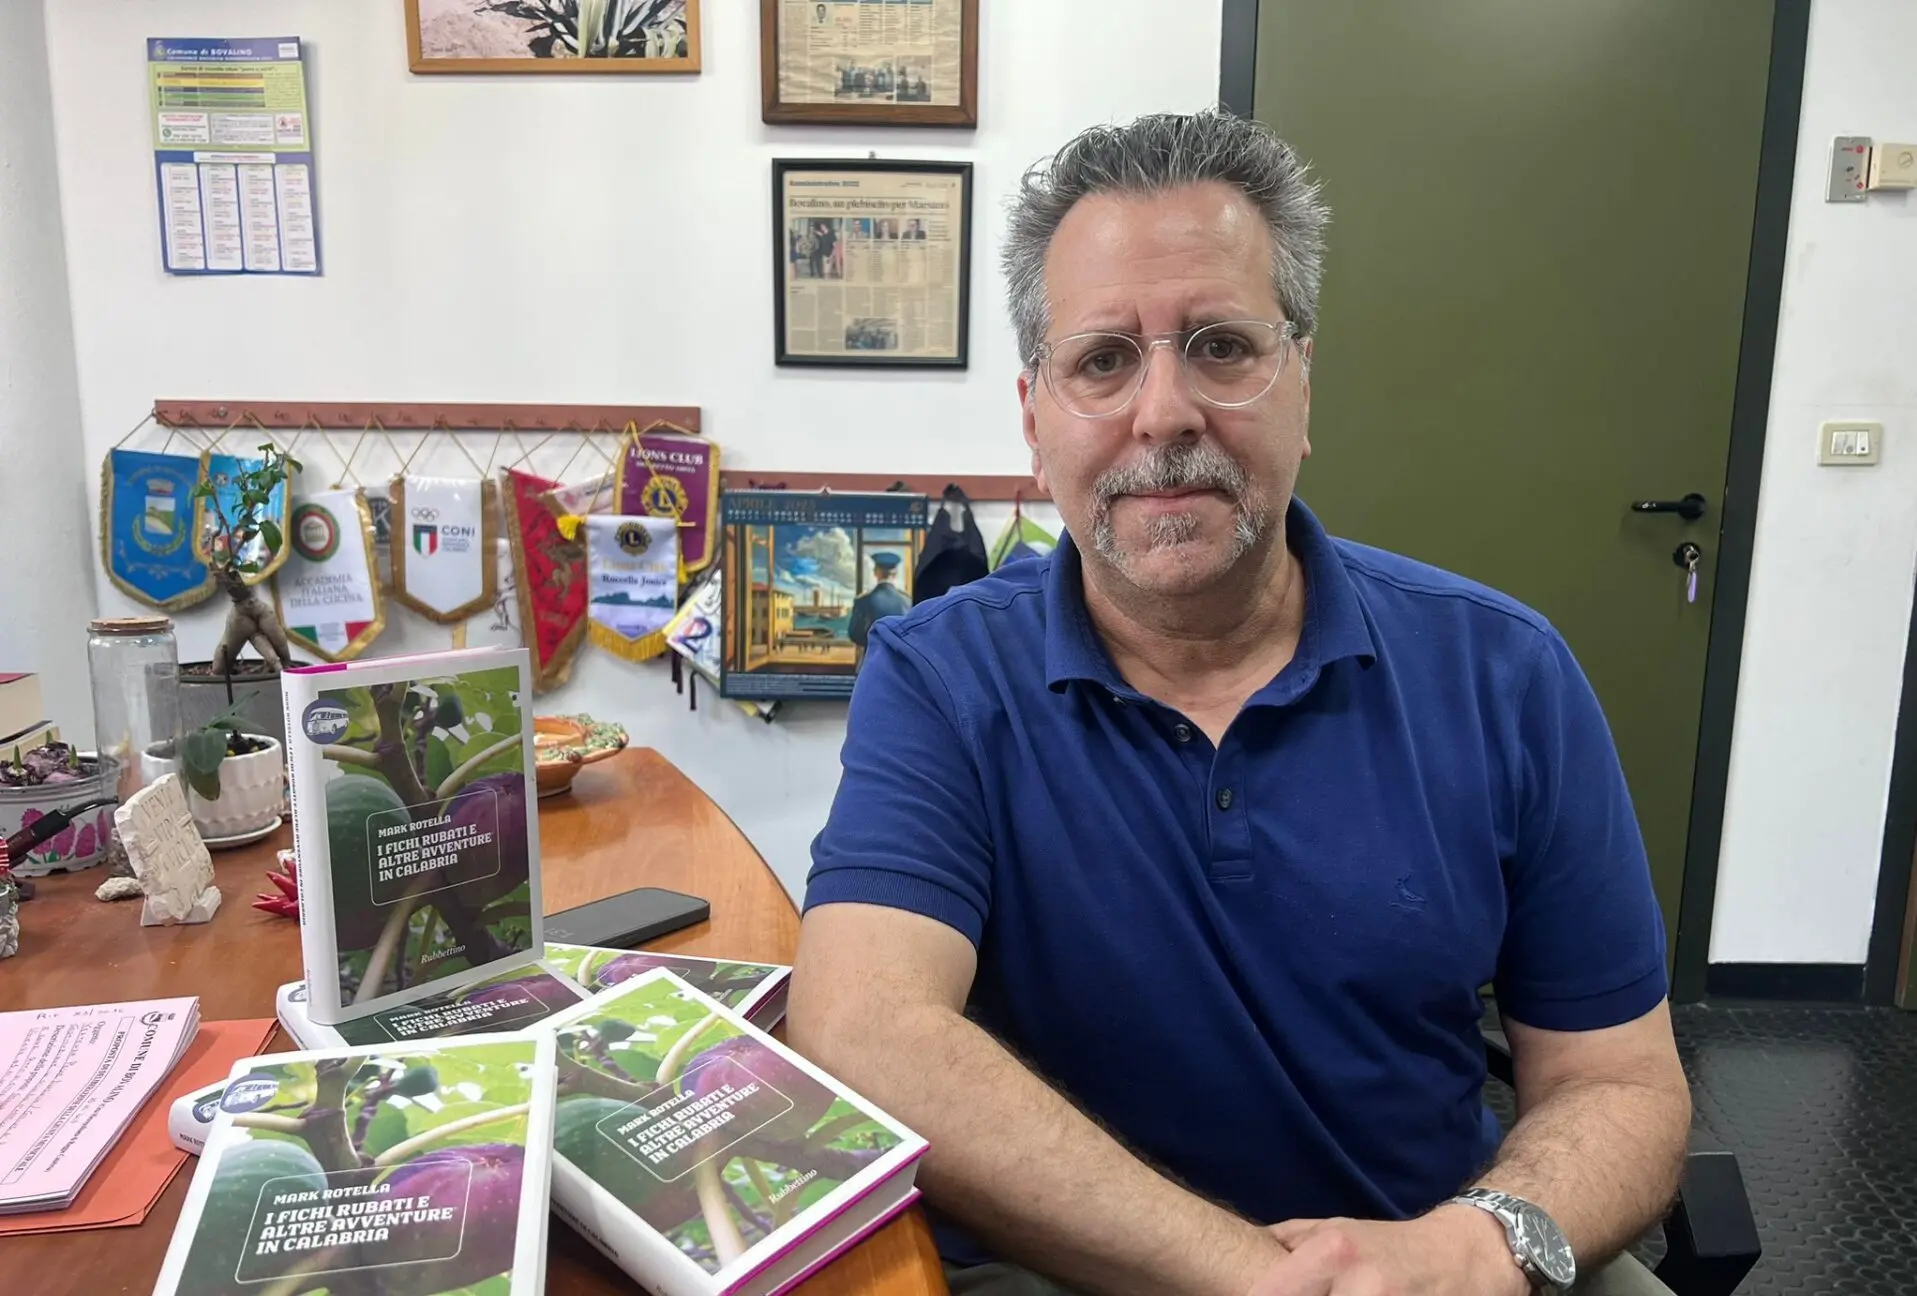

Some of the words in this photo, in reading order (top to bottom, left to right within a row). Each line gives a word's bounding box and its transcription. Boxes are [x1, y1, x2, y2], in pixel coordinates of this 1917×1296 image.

[211, 48, 252, 56] BOVALINO
[630, 447, 667, 461] LIONS
[669, 452, 704, 465] CLUB
[441, 524, 476, 538] CONI
[295, 572, 353, 587] ACCADEMIA
[601, 573, 639, 584] Roccella
[377, 845, 383, 857] I
[385, 837, 420, 855] FICHI
[422, 828, 468, 847] RUBATI
[469, 824, 477, 835] E
[378, 824, 408, 838] MARK
[409, 815, 451, 831] ROTELLA
[378, 850, 420, 869] ALTRE
[421, 832, 492, 859] AVVENTURE
[379, 869, 394, 882] IN
[396, 853, 458, 878] CALABRIA
[421, 944, 466, 964] Rubbettino
[389, 1010, 420, 1022] MARK
[424, 1000, 472, 1014] ROTELLA
[397, 1017, 443, 1032] ALTRE
[444, 998, 530, 1022] AVVENTURE
[419, 1011, 493, 1033] CALABRIA
[105, 1031, 125, 1063] PROPOSTA
[134, 1024, 158, 1062] COMUNE
[129, 1063, 141, 1072] DI
[617, 1114, 651, 1135] MARK
[648, 1089, 696, 1117] ROTELLA
[627, 1137, 640, 1148] I
[637, 1116, 676, 1144] FICHI
[673, 1092, 725, 1122] RUBATI
[721, 1084, 735, 1096] E
[639, 1125, 686, 1156] ALTRE
[683, 1083, 760, 1130] AVVENTURE
[648, 1148, 670, 1165] IN
[666, 1111, 736, 1153] CALABRIA
[273, 1191, 320, 1206] MARK
[322, 1183, 391, 1200] ROTELLA
[260, 1220, 327, 1240] ALTRE
[330, 1207, 454, 1232] AVVENTURE
[264, 1212, 275, 1226] I
[276, 1206, 333, 1224] FICHI
[336, 1197, 415, 1218] RUBATI
[416, 1195, 430, 1209] E
[255, 1240, 279, 1255] IN
[283, 1228, 389, 1252] CALABRIA
